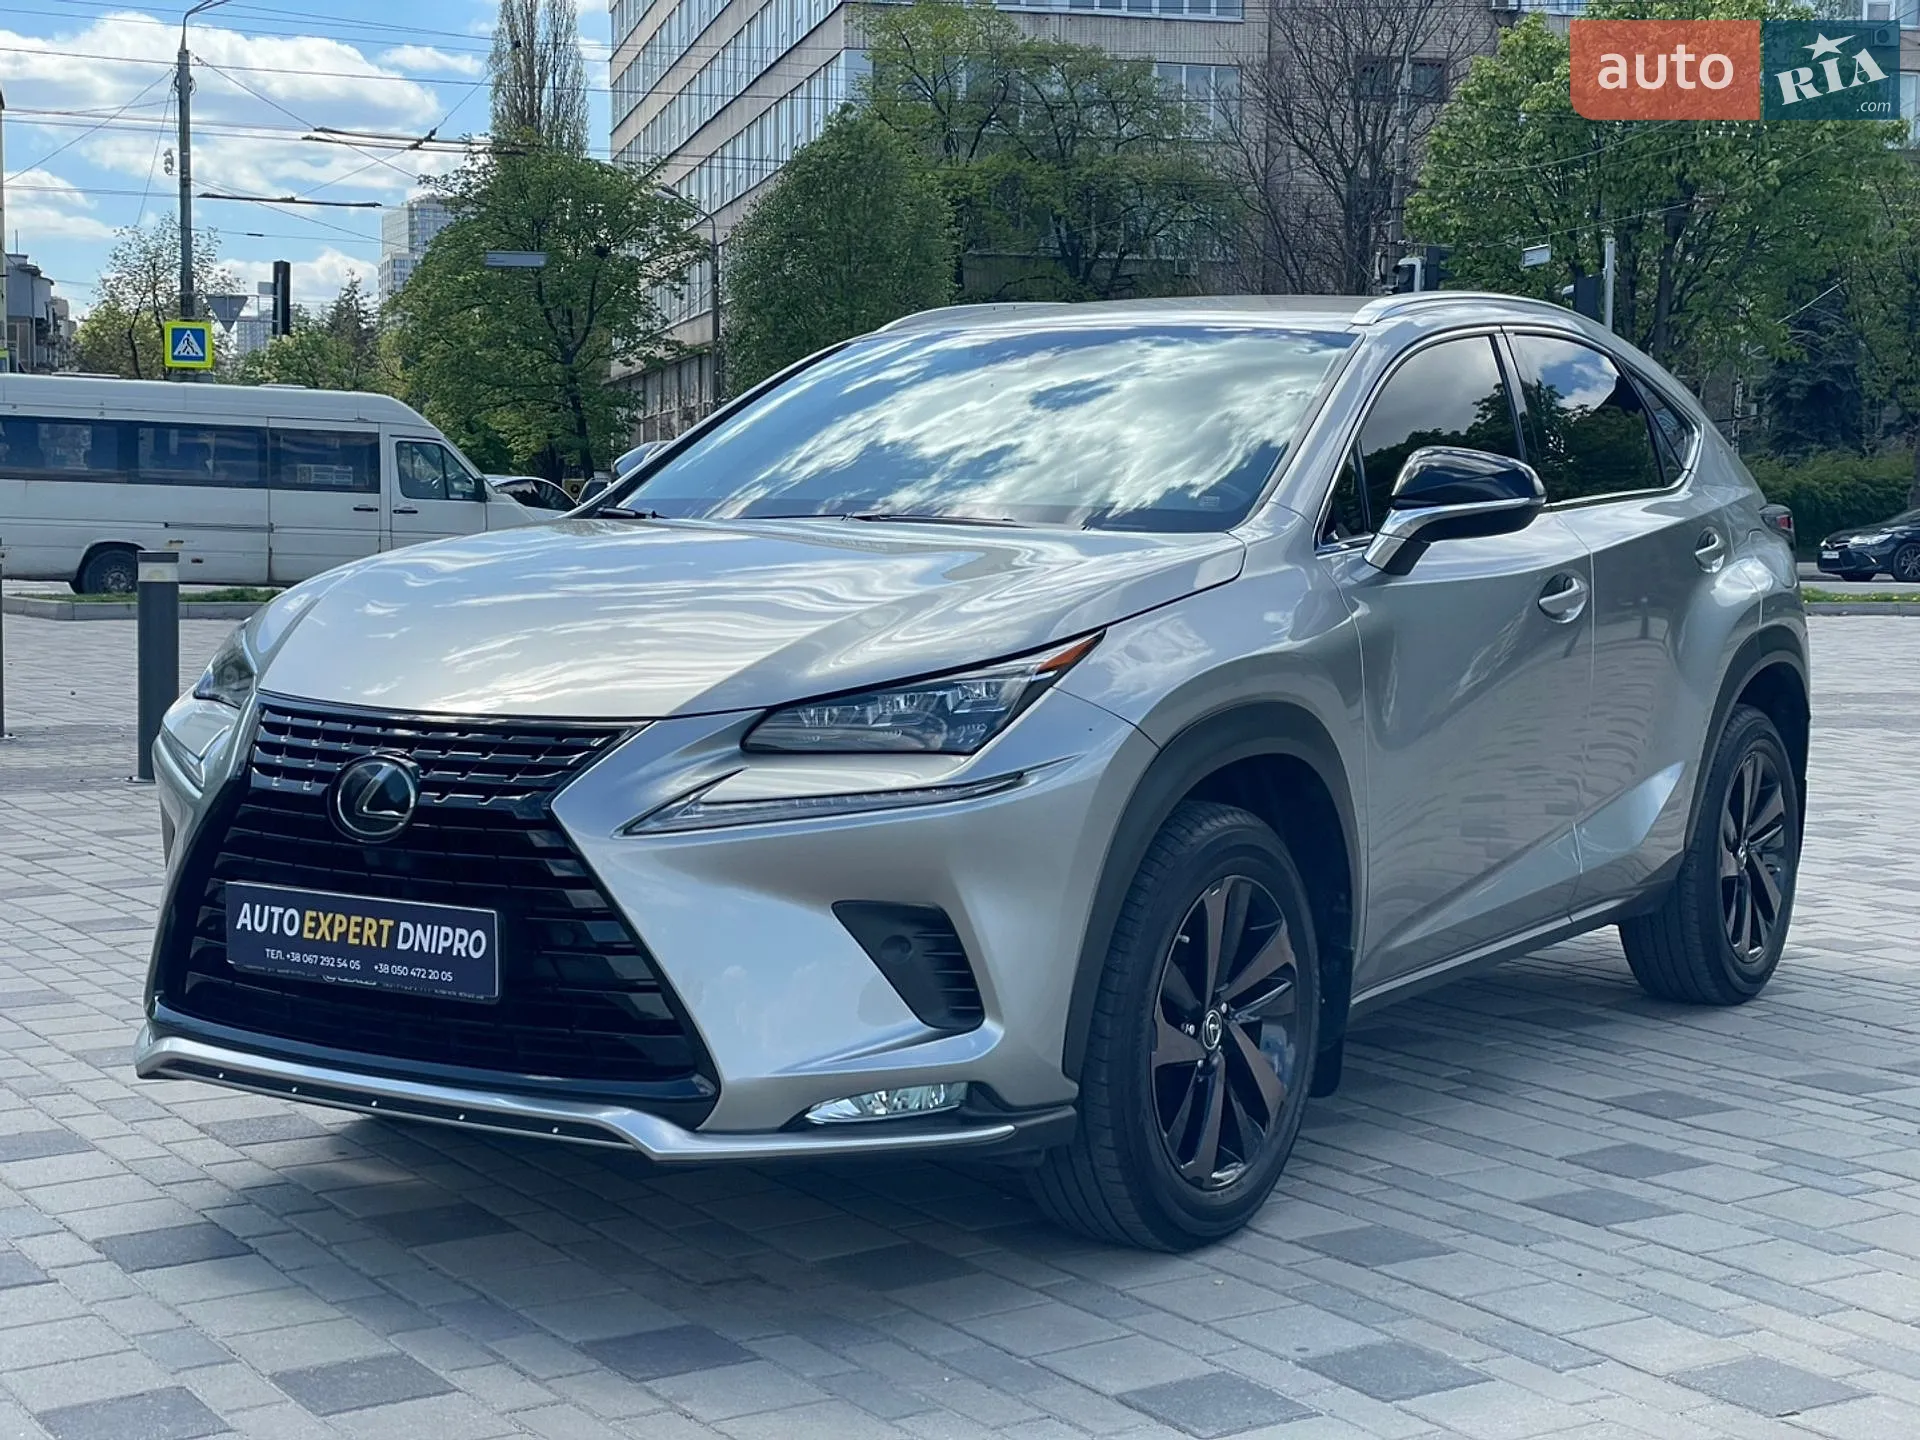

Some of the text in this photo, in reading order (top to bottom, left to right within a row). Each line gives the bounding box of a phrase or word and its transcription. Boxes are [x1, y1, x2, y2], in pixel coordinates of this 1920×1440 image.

[236, 902, 487, 959] AUTO EXPERT DNIPRO
[320, 955, 335, 968] 292
[410, 967, 427, 979] 472
[428, 969, 440, 980] 20
